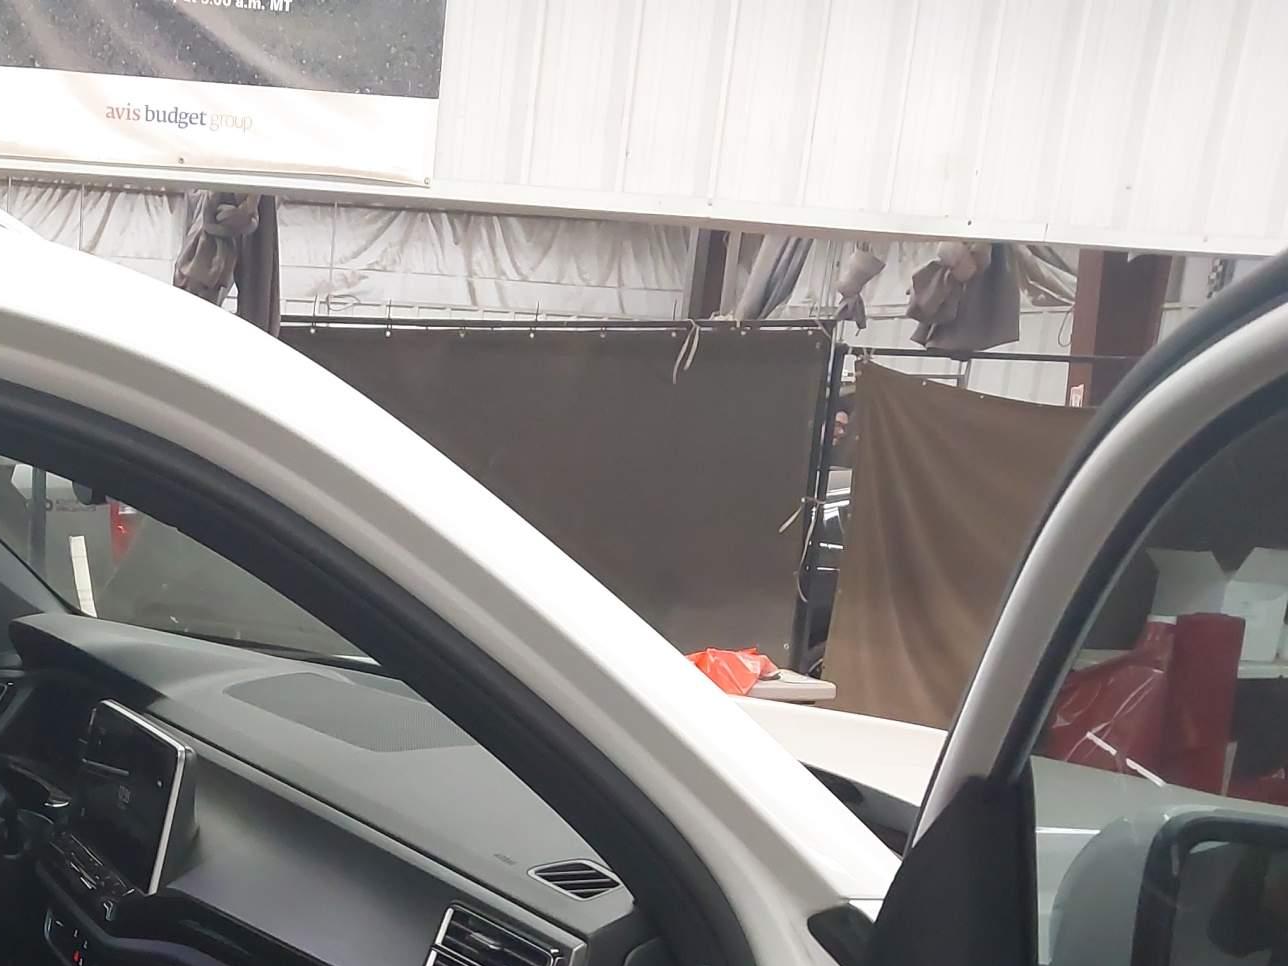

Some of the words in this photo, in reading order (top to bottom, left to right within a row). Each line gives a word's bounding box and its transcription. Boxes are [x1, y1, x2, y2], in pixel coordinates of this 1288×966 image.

[235, 0, 266, 10] a.m.
[270, 0, 293, 12] MT
[105, 102, 141, 121] avis
[144, 104, 207, 129] budget
[209, 112, 253, 136] group
